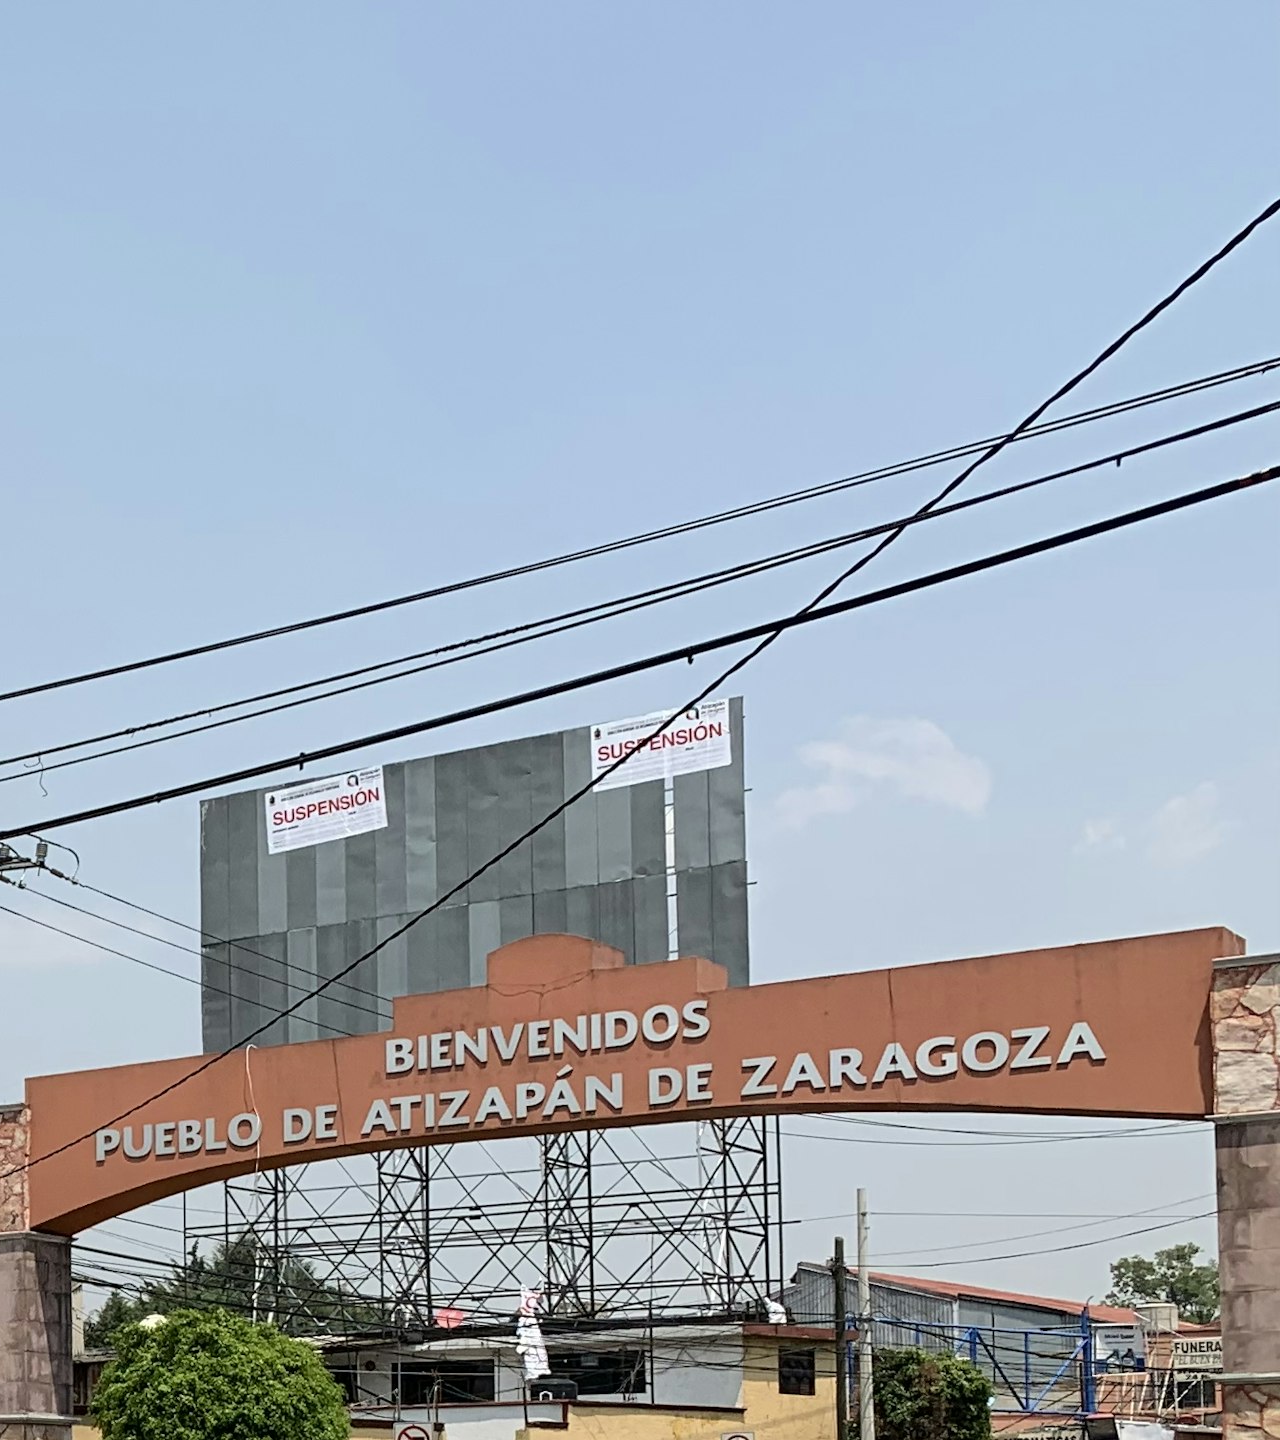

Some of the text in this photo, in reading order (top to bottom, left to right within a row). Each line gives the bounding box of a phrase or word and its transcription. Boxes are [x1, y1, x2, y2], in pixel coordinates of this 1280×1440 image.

[598, 721, 723, 761] SUSPENSIÓN
[272, 787, 380, 826] SUSPENSIÓN
[384, 1000, 710, 1075] BIENVENIDOS
[95, 1021, 1107, 1163] PUEBLO DE ATIZAPÁN DE ZARAGOZA
